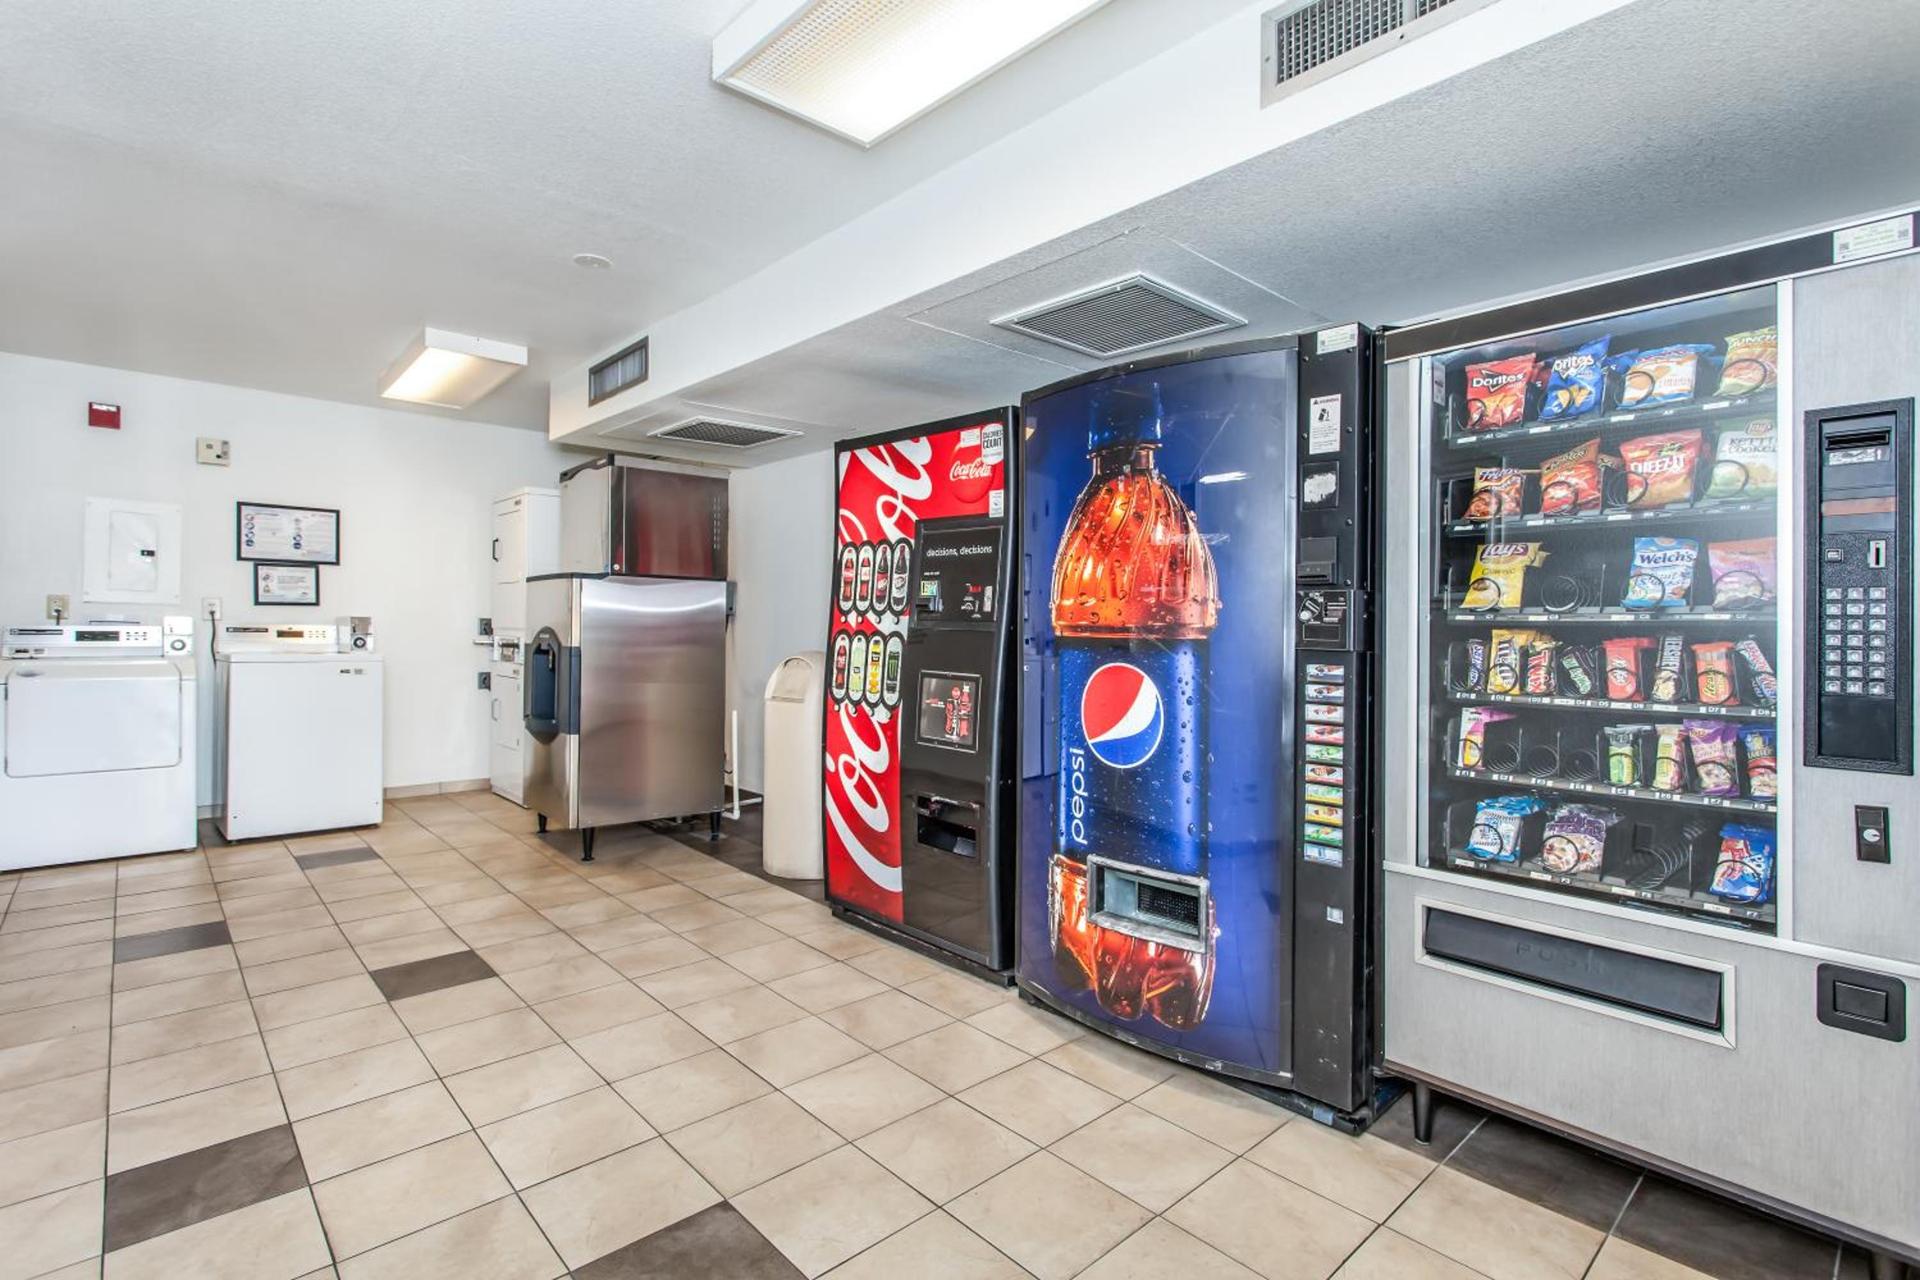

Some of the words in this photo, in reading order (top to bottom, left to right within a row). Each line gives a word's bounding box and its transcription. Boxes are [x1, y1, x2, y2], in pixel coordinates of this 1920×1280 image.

[1472, 371, 1524, 388] Doritos
[960, 544, 993, 555] decisions
[1639, 550, 1697, 565] Welch's
[1070, 747, 1089, 846] pepsi
